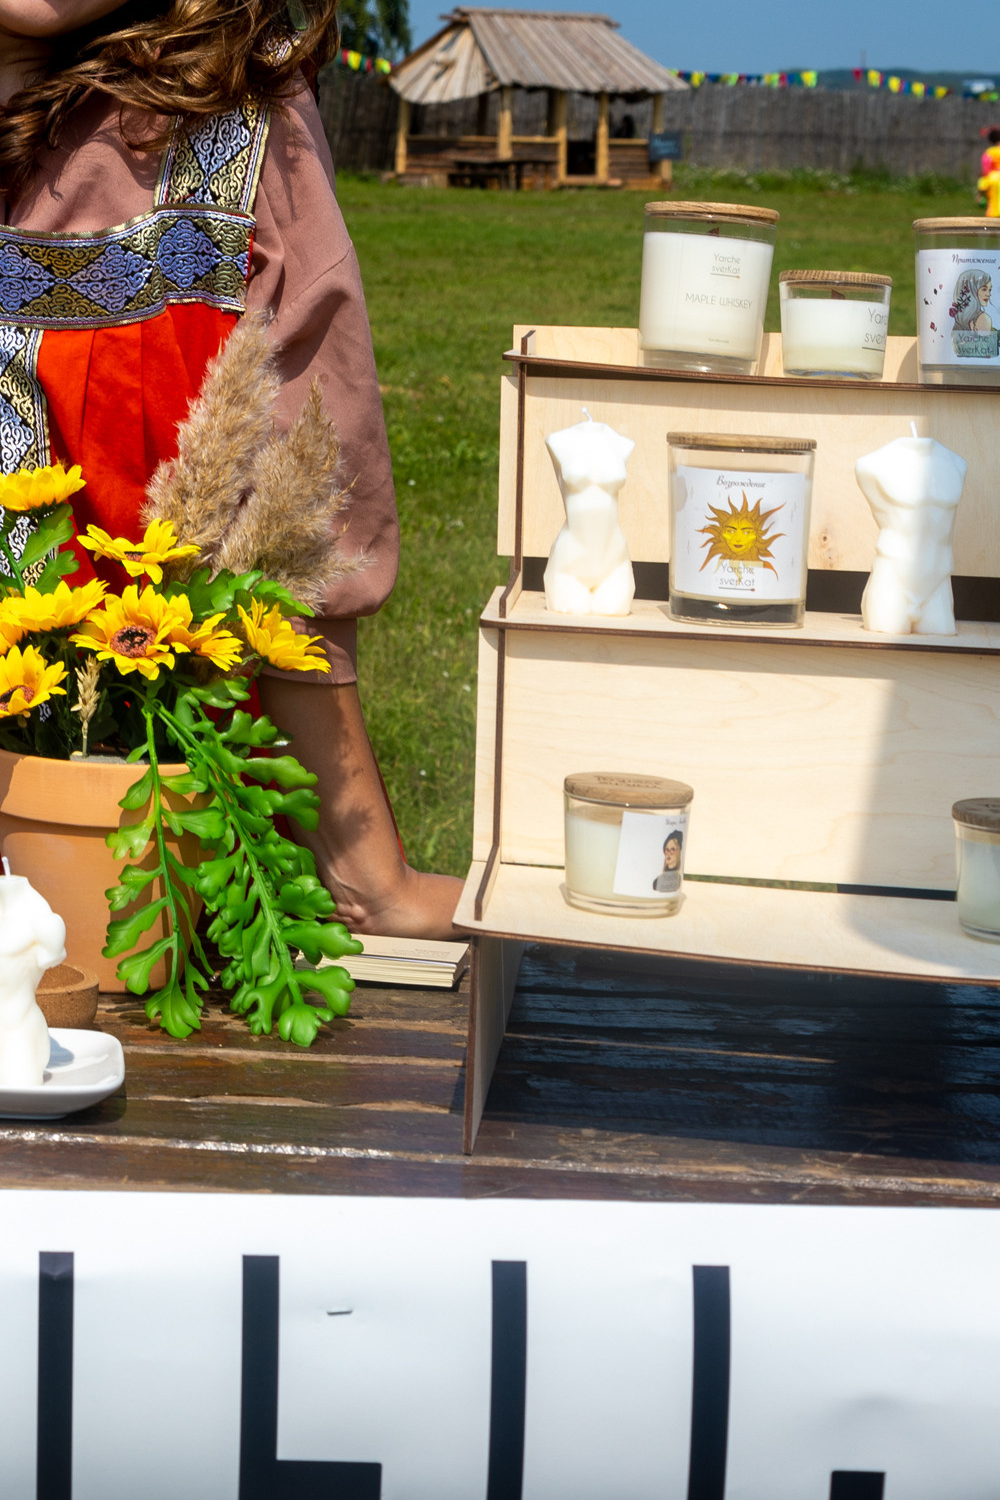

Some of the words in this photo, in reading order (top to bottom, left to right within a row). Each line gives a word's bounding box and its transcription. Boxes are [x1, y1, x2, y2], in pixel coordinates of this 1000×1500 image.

[713, 253, 740, 264] Yarche
[685, 293, 717, 306] MAPLE
[719, 297, 753, 309] WHISKEY
[721, 563, 754, 575] Yarche
